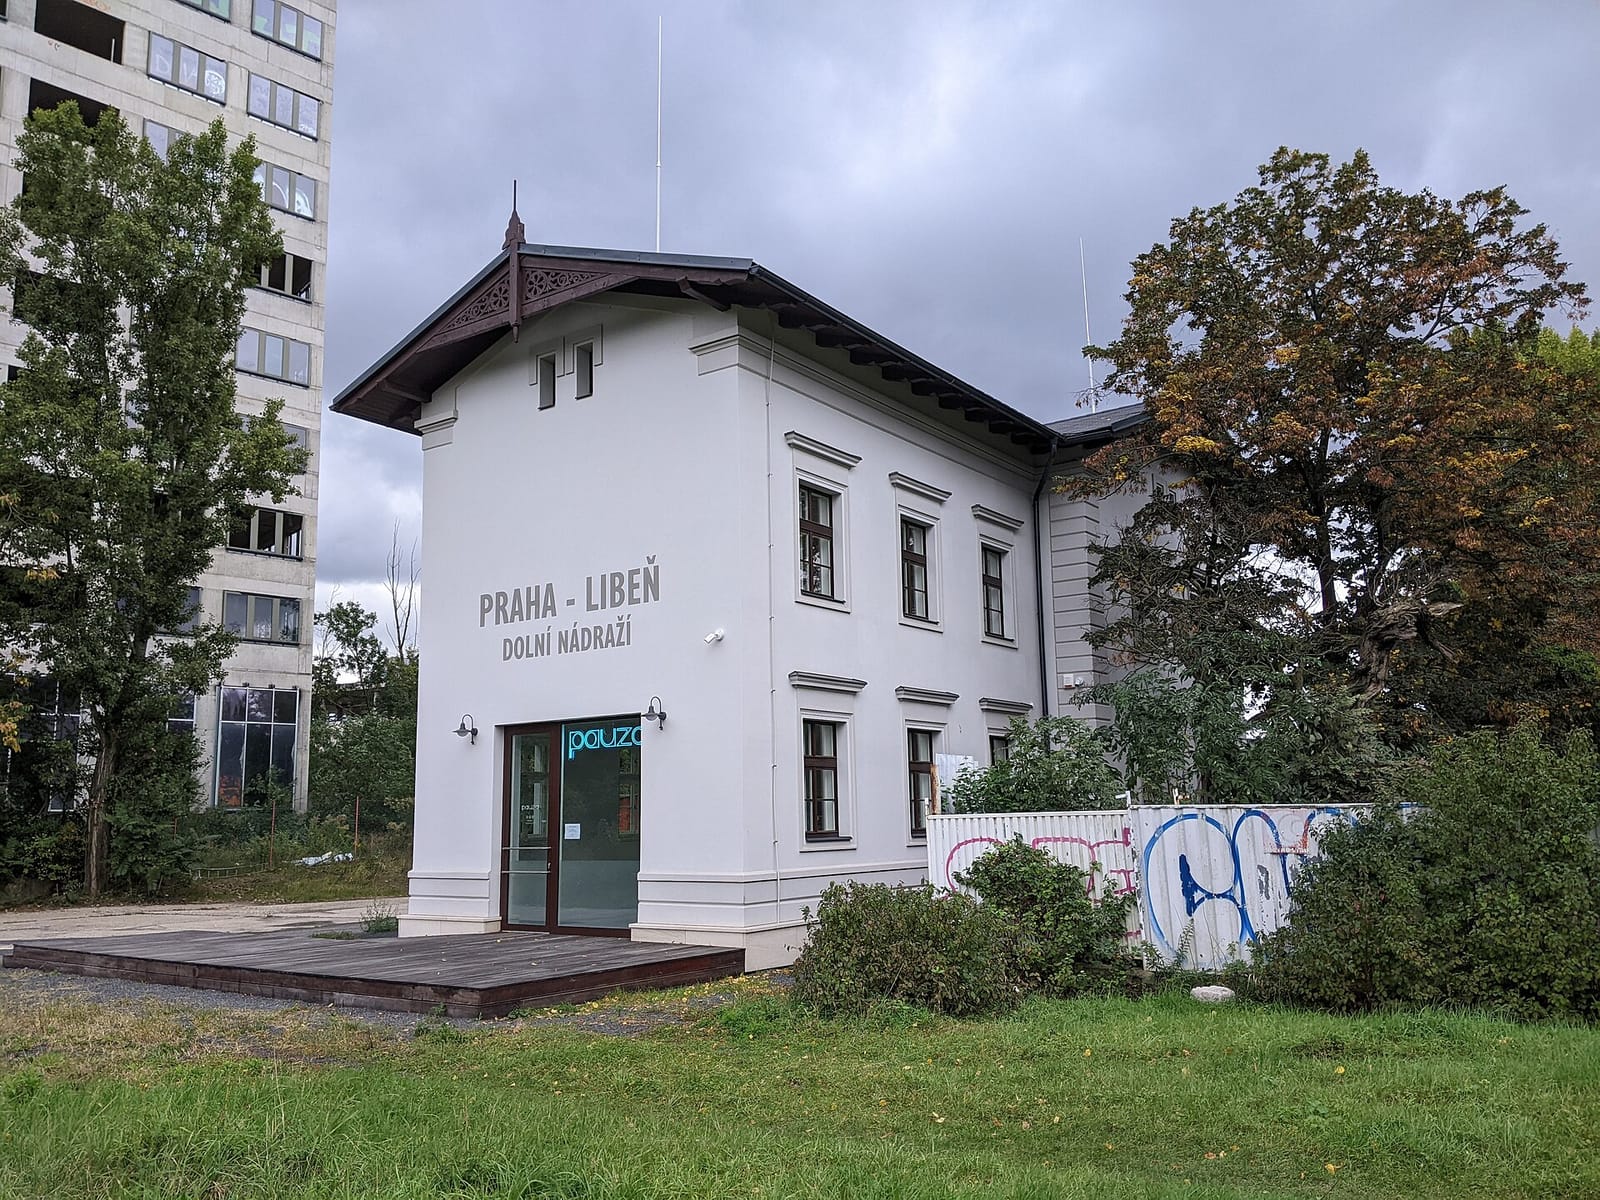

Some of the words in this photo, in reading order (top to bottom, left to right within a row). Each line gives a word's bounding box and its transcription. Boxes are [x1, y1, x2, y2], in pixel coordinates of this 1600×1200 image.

[480, 583, 557, 627] PRAHA
[586, 555, 660, 611] LIBEŇ
[502, 626, 551, 661] DOLNÍ
[558, 614, 631, 654] NÁDRAŽÍ
